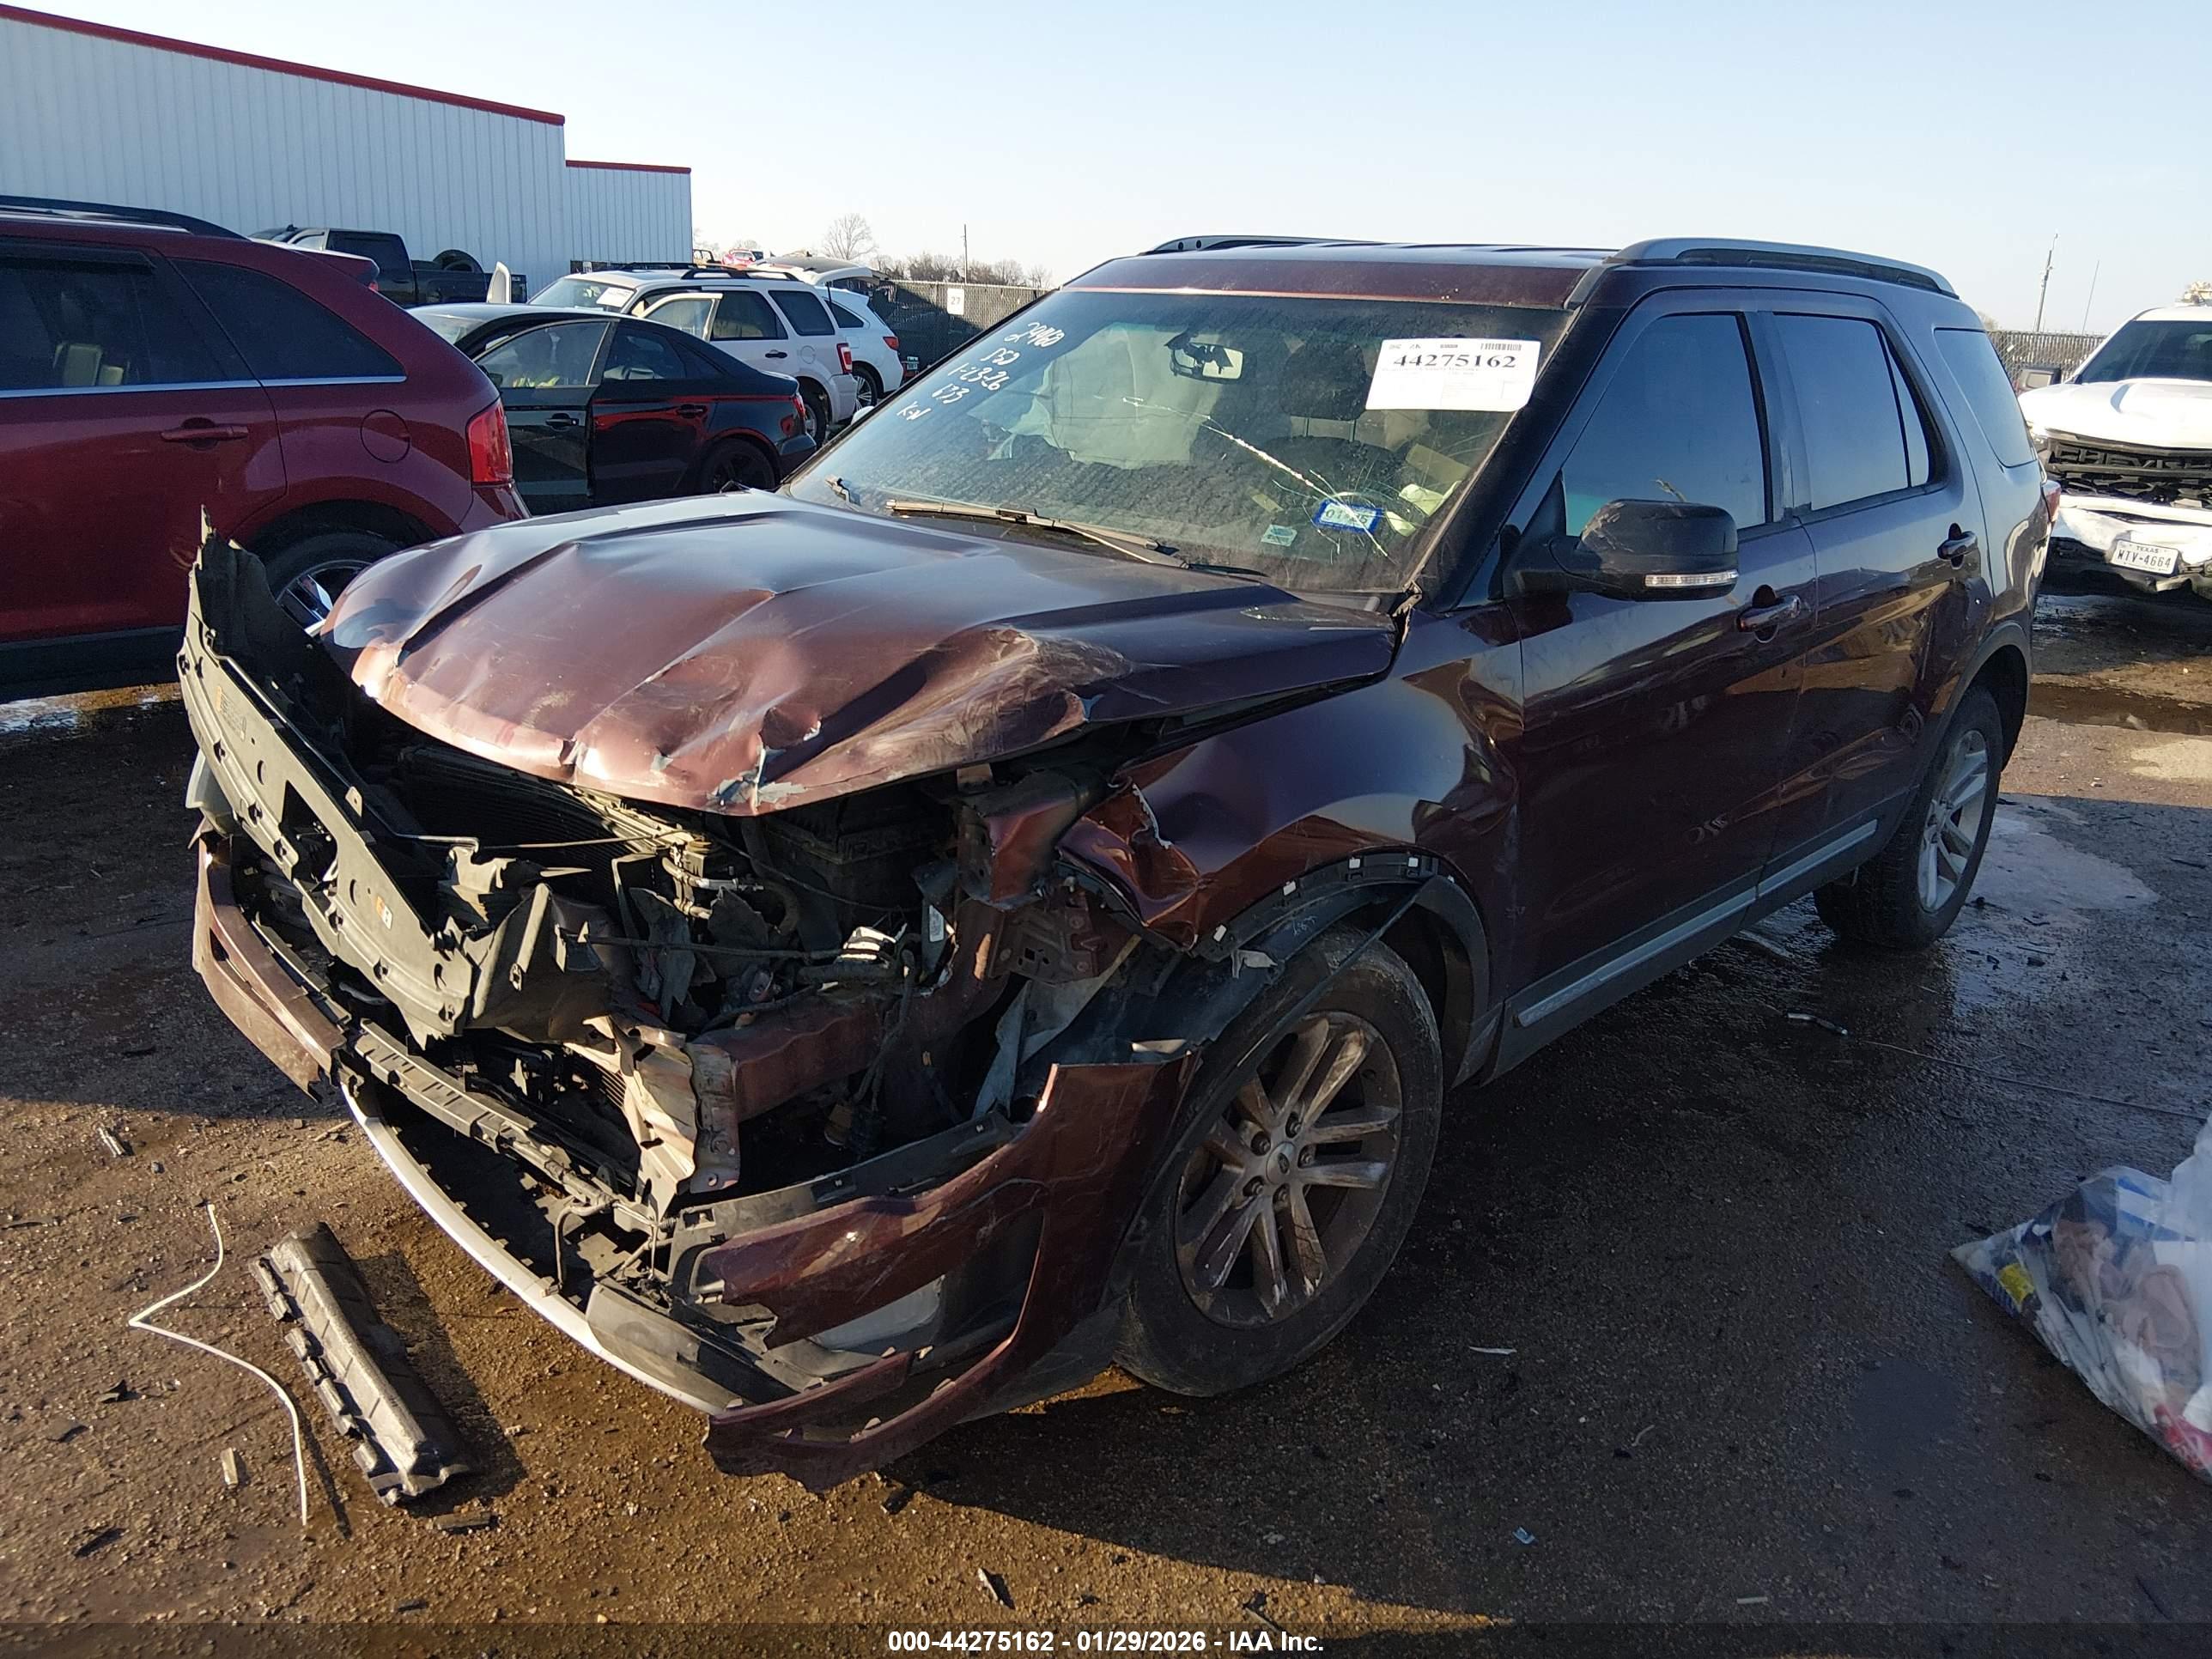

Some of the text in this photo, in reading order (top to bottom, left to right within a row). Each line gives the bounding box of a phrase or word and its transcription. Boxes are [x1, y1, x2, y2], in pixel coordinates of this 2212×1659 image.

[951, 296, 961, 306] 27
[1394, 354, 1516, 368] 44275162
[2136, 545, 2160, 554] TEXAS
